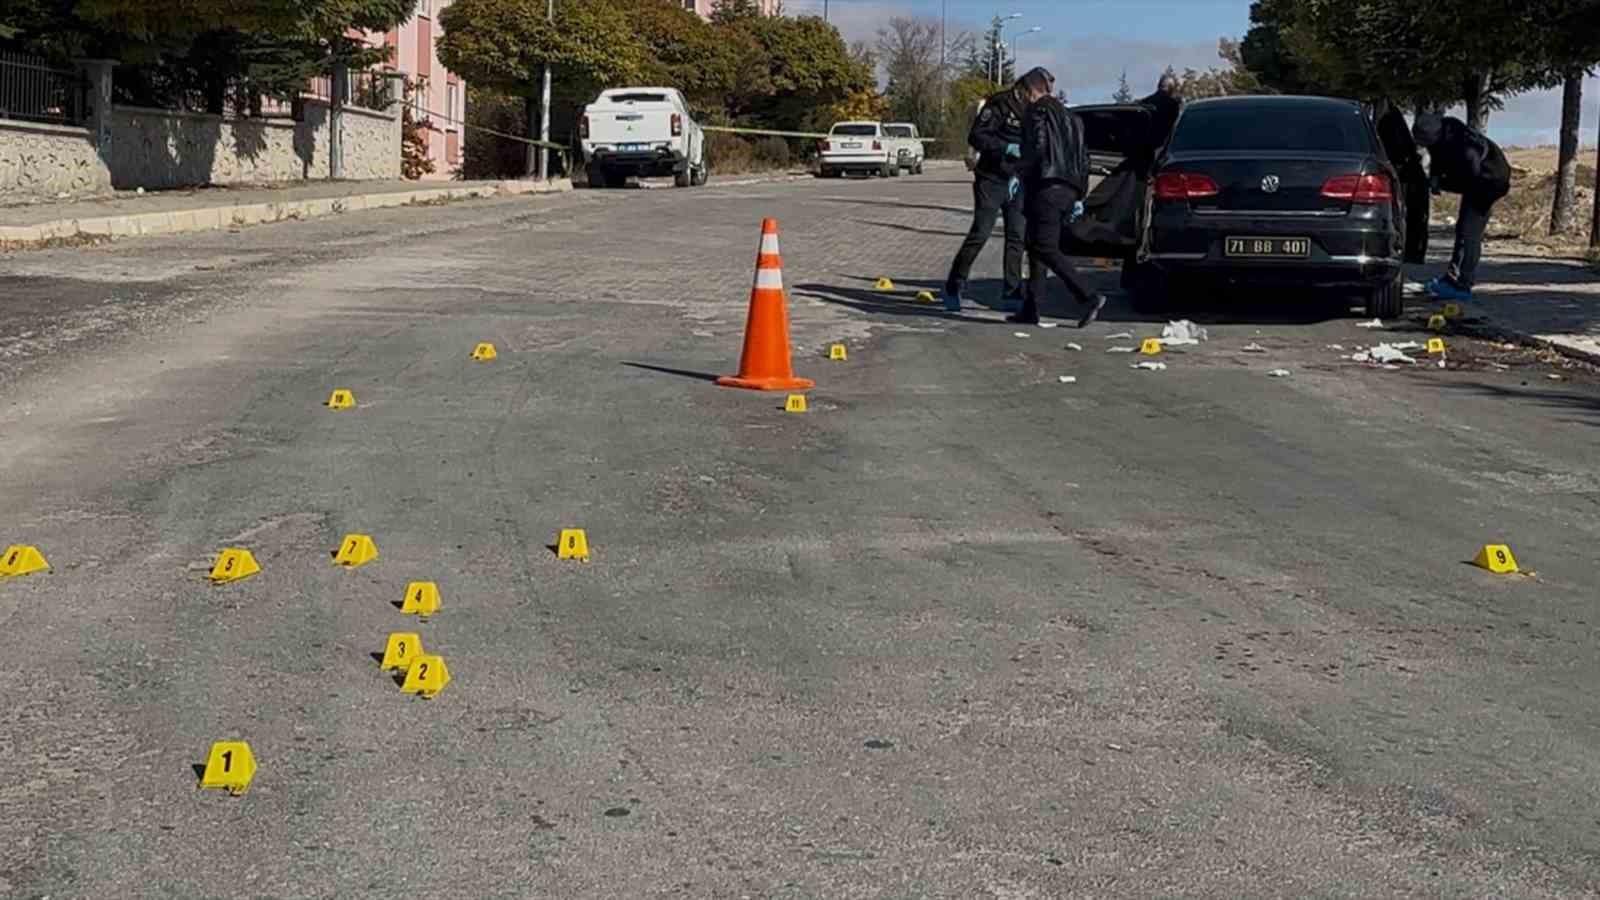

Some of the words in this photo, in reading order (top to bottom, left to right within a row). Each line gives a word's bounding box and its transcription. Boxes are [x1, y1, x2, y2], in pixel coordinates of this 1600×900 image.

[1231, 240, 1244, 252] 71
[1283, 240, 1306, 253] 401
[792, 400, 800, 409] 11
[348, 541, 357, 554] 7
[569, 537, 576, 550] 8
[8, 551, 18, 566] 6
[225, 557, 235, 571] 5
[1496, 550, 1506, 564] 9
[415, 589, 423, 603] 4
[398, 642, 406, 658] 3
[418, 664, 428, 681] 2
[222, 751, 232, 772] 1
